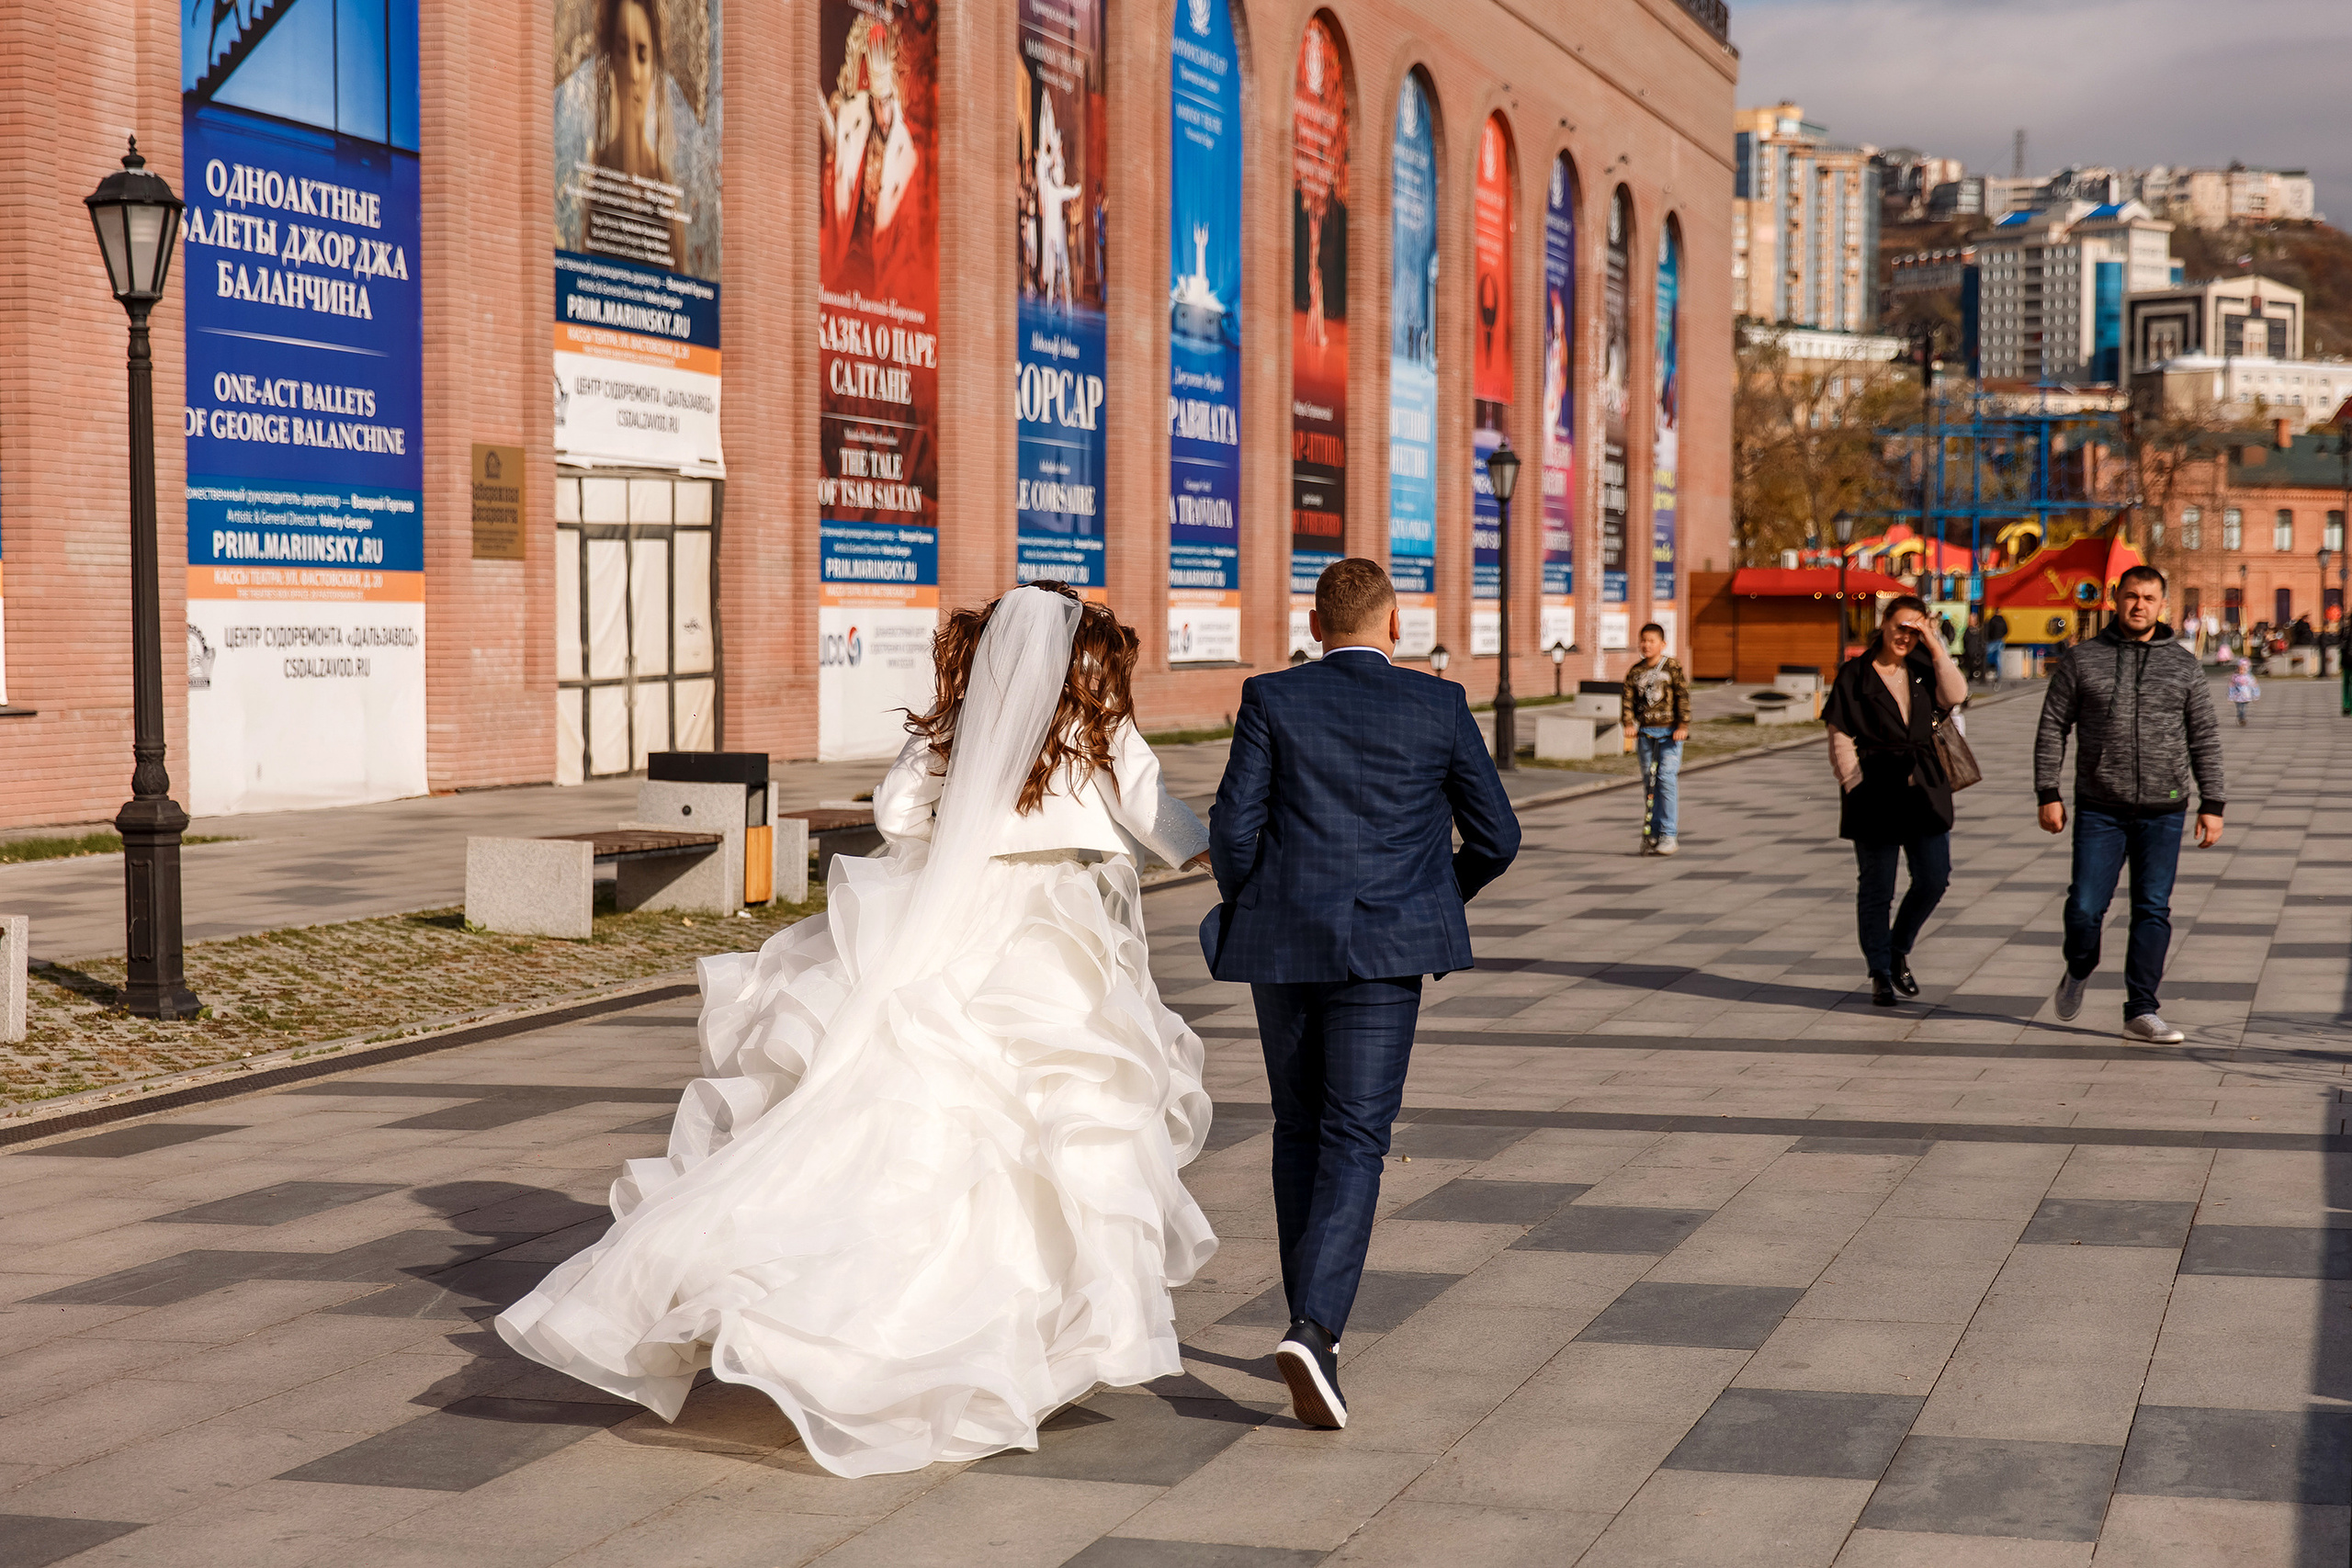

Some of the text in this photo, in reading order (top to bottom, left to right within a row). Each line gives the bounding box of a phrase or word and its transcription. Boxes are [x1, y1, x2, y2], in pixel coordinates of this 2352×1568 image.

[206, 158, 381, 230] ОДНОАКТНЫЕ
[281, 222, 409, 282] ДЖОРДЖА
[217, 259, 373, 321] БАЛАНЧИНА
[567, 293, 691, 339] PRIM.MARIINSKY.RU
[875, 323, 890, 360] О
[891, 326, 937, 369] ЦАРЕ
[214, 371, 377, 418] ONE-ACT BALLETS
[830, 356, 912, 405] САЛТАНЕ
[184, 406, 406, 456] OF GEORGE BALANCHINE
[839, 446, 904, 480] THE TALE
[818, 476, 922, 513] OF TSAR SALTAN
[226, 508, 254, 525] Artistic
[260, 509, 287, 526] General
[318, 513, 344, 531] Valery
[343, 513, 373, 533] Gergiev
[212, 530, 384, 564] PRIM.MARIINSKY.RU
[224, 626, 262, 651] ЦЕНТР
[264, 626, 343, 650] СУДОРЕМОНТА
